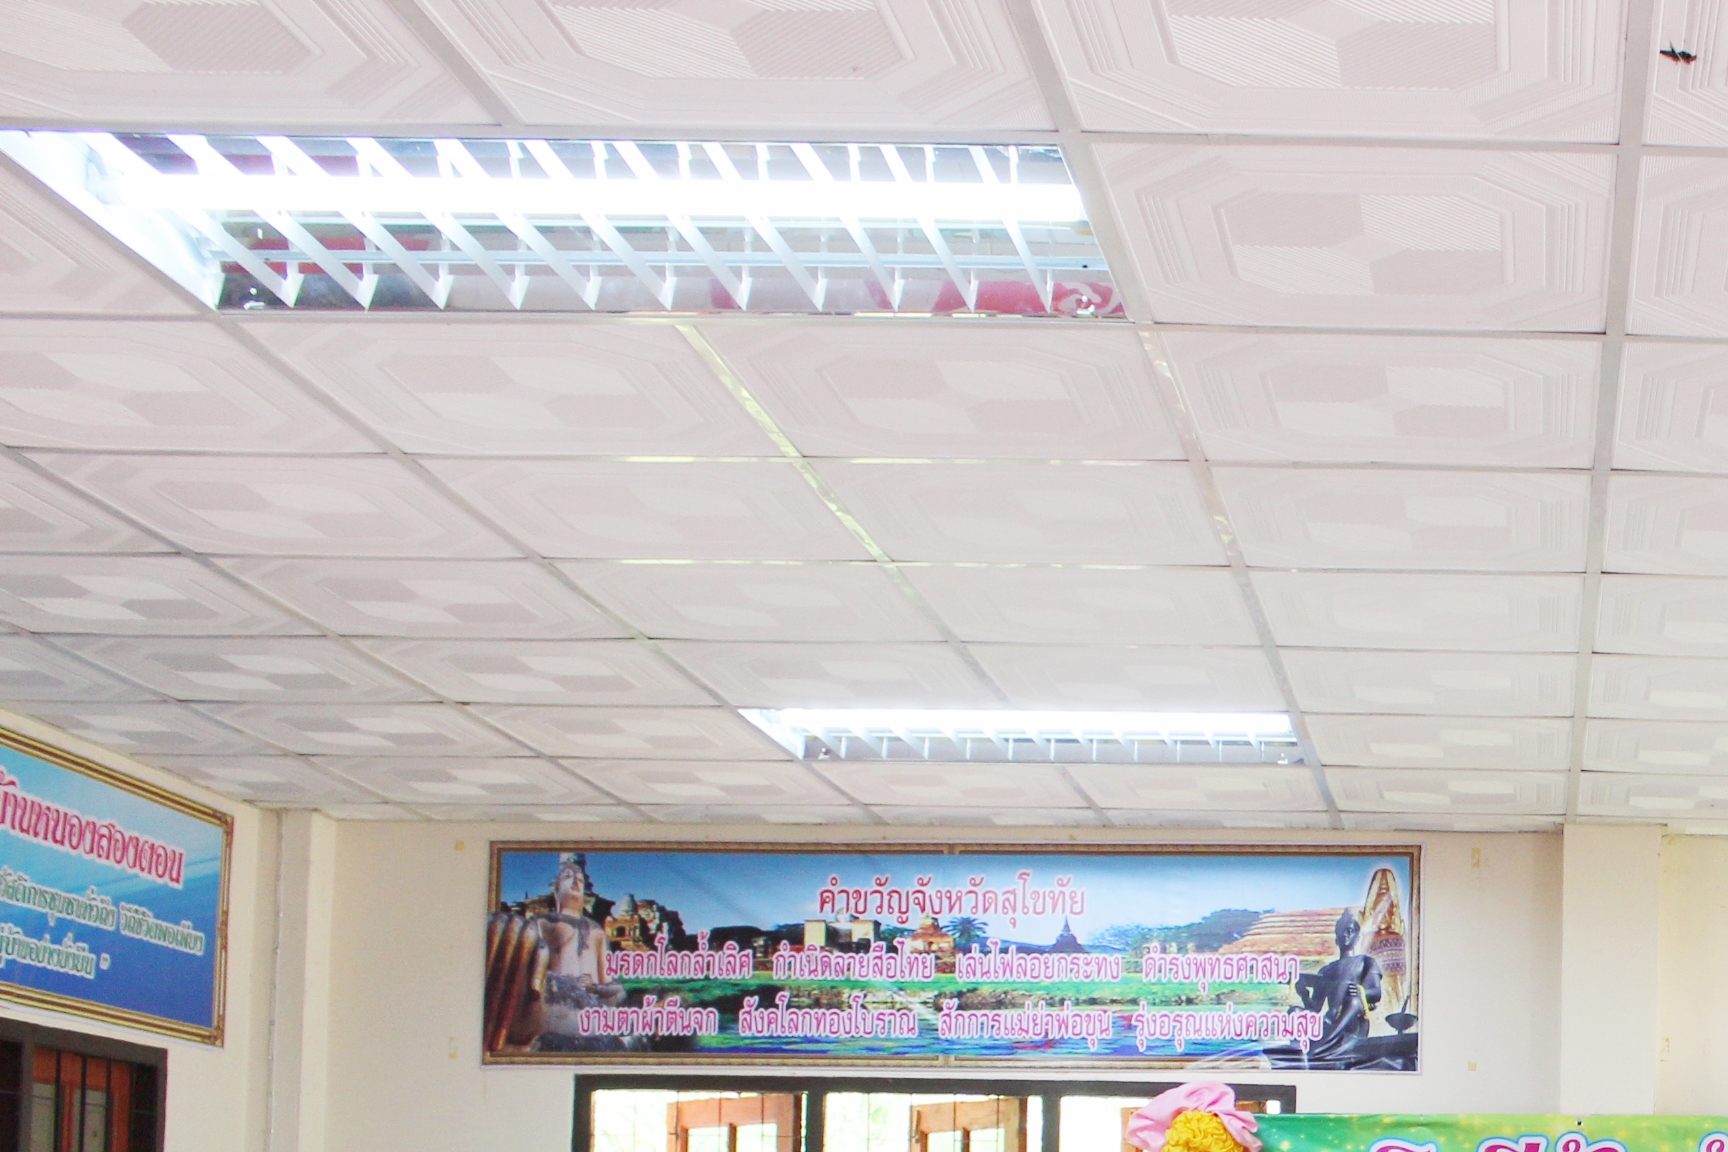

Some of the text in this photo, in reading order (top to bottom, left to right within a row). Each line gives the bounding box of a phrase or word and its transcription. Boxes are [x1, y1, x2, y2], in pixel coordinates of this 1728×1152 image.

[0, 770, 184, 885] ้านหนองสองตอน
[819, 872, 1086, 927] คำขวัญจังหวัดสุโขทัย
[606, 931, 1298, 992] มรดกโลกล้ำเลิศ กำเนิดลายสือไทย เล่นไฟลอยกระทง ดำรงพุทธศาสนา
[579, 993, 1322, 1051] งามตาผ้าตีนจก สังคโลกทองโบราณ สักการแม่ย่าพ่อขุน รุ่งอรุณแห่งความสุข
